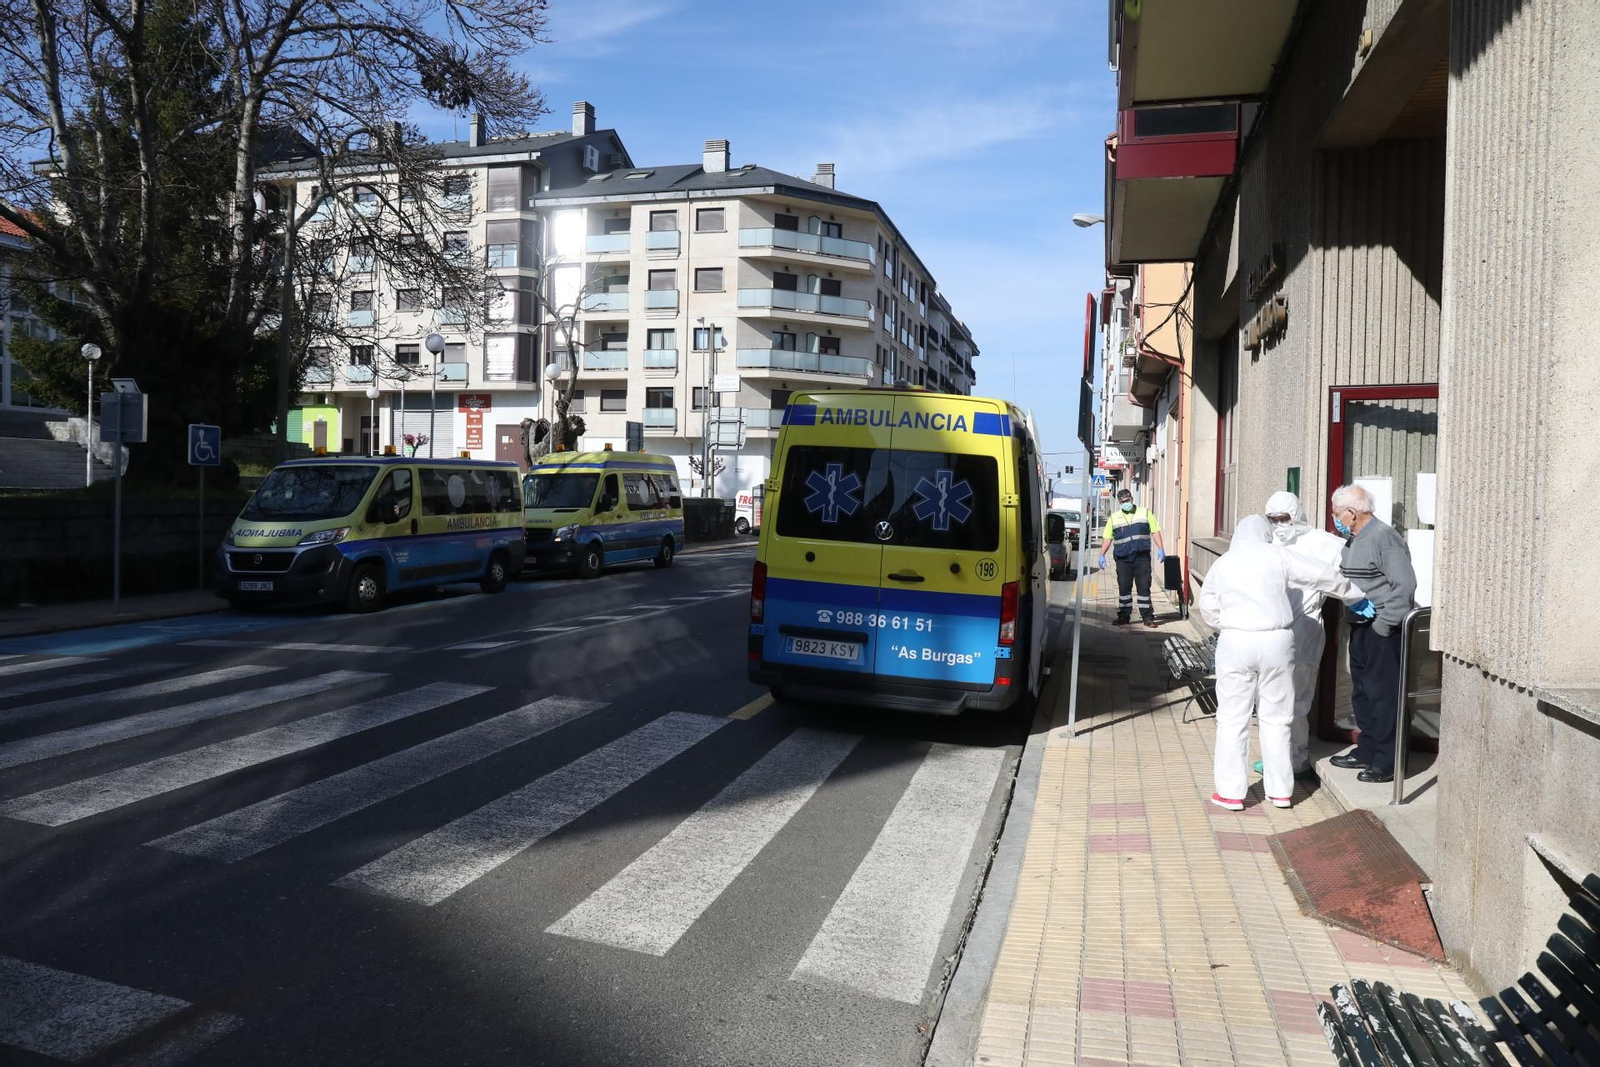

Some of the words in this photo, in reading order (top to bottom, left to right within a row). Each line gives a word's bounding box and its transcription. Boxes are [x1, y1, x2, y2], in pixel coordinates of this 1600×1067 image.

[819, 407, 968, 432] AMBULANCIA
[446, 516, 498, 530] AMBULANCIA
[978, 561, 995, 577] 198
[836, 610, 864, 626] 988
[868, 614, 887, 628] 36
[891, 616, 909, 630] 61
[915, 618, 933, 632] 51
[795, 639, 826, 655] 9823
[830, 643, 856, 658] KSY
